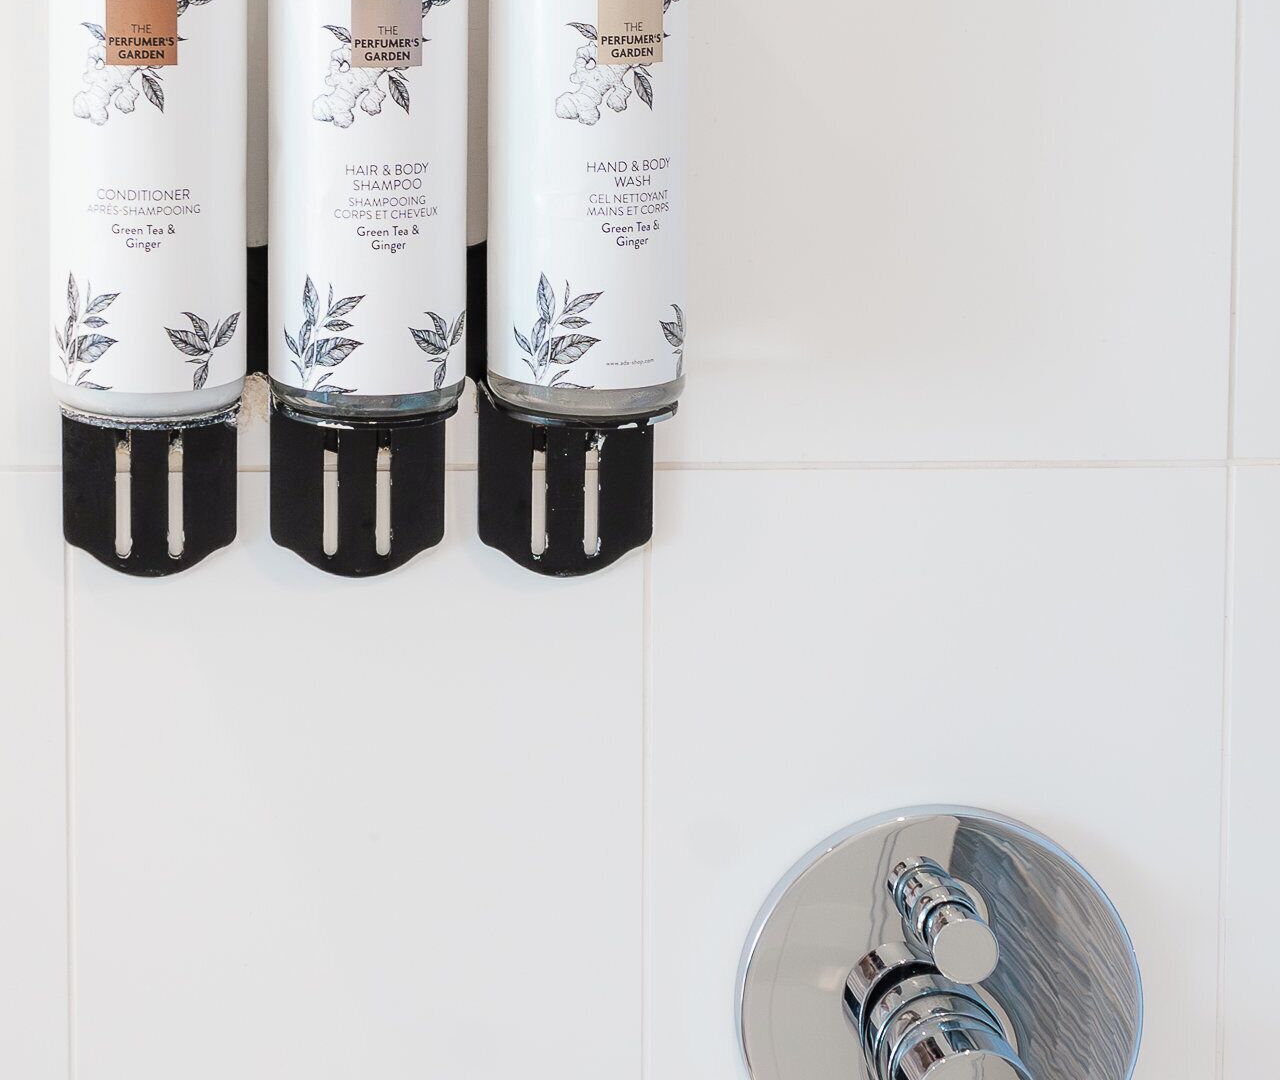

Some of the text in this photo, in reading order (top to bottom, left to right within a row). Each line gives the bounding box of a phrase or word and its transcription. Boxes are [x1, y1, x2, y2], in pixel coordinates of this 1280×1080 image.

[131, 24, 152, 34] THE
[377, 25, 398, 35] THE
[624, 21, 643, 32] THE
[118, 50, 165, 59] GARDEN
[364, 51, 410, 61] GARDEN
[611, 47, 654, 58] GARDEN
[345, 162, 429, 176] HAIR & BODY
[586, 157, 671, 173] HAND & BODY
[352, 178, 422, 191] SHAMPOO
[614, 174, 651, 187] WASH
[97, 188, 190, 201] CONDITIONER
[348, 195, 426, 207] SHAMPOOING
[589, 189, 668, 204] GEL NETTOYANT
[333, 206, 438, 220] CORPS ET CHEVEUX
[586, 201, 670, 216] MAINS ET CORPS
[111, 223, 176, 235] Green Tea &
[356, 224, 420, 236] Green Tea &
[601, 219, 660, 233] Green Tea &
[126, 238, 162, 252] Ginger
[371, 240, 406, 254] Ginger
[616, 236, 649, 249] Ginger
